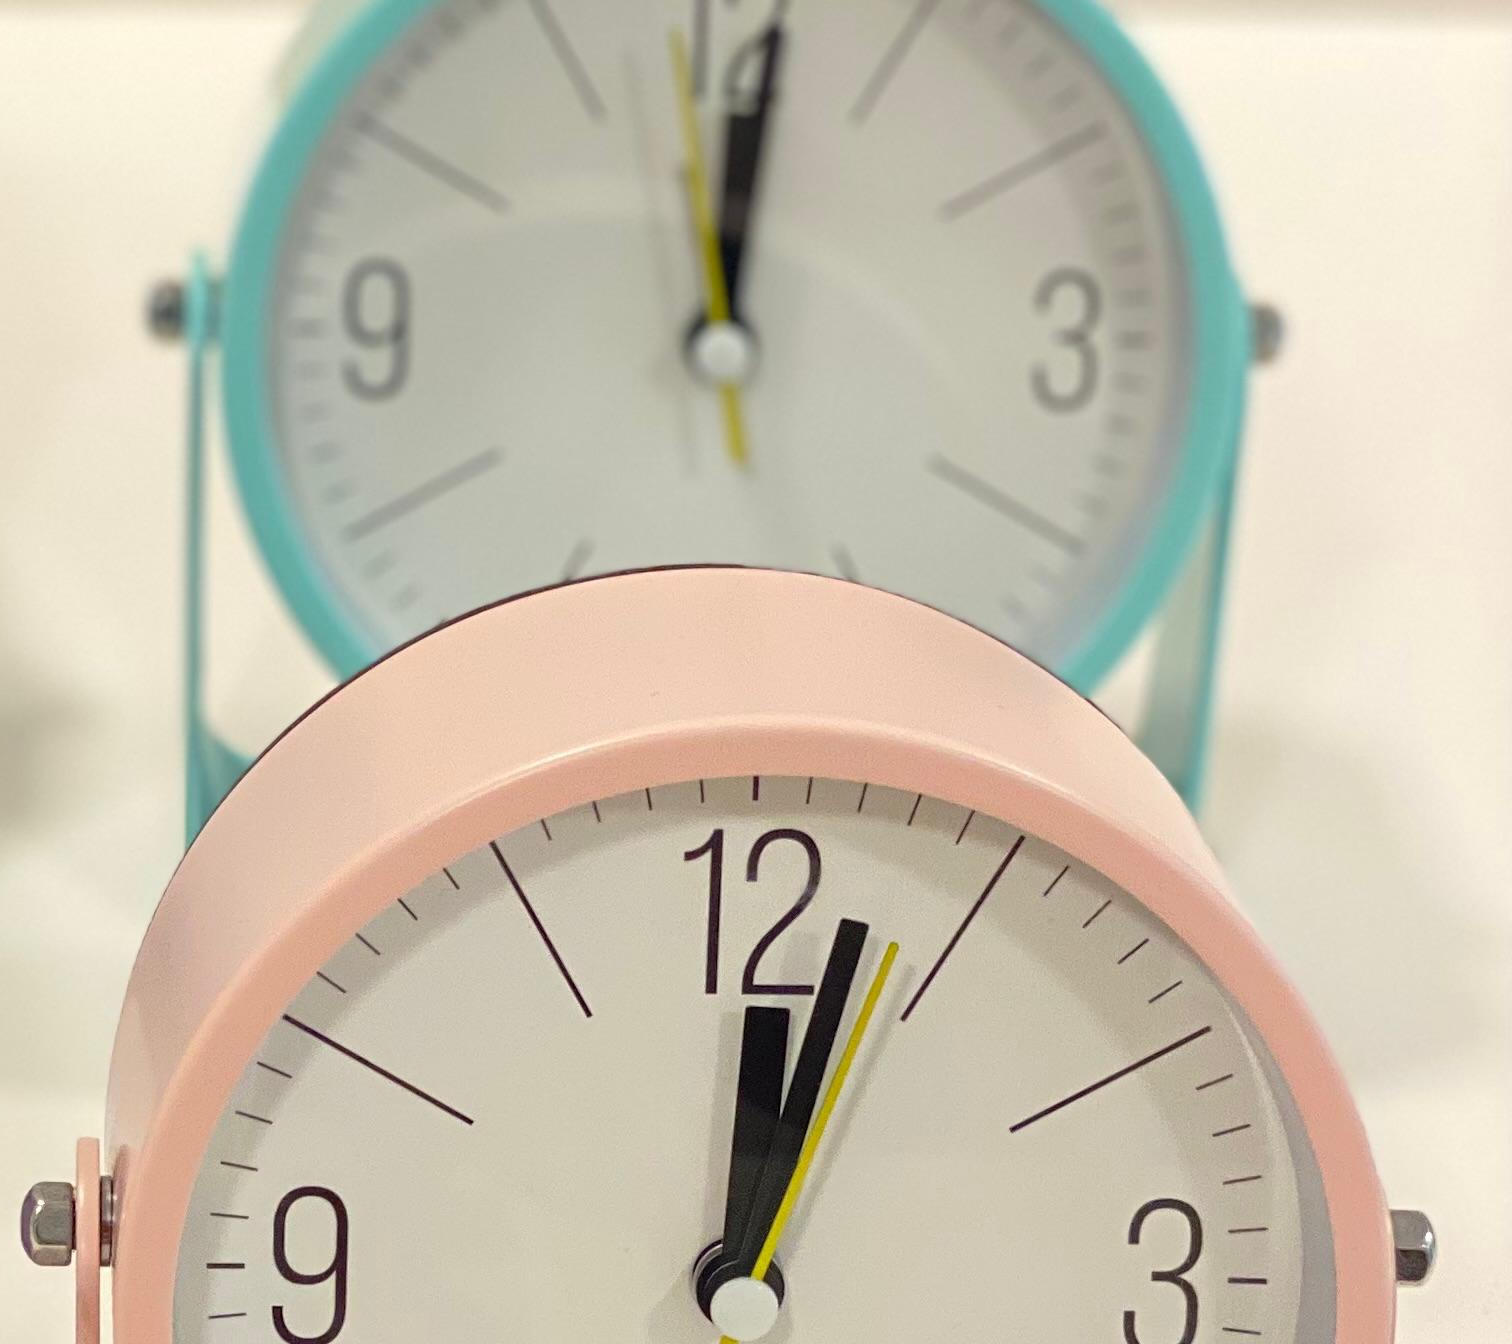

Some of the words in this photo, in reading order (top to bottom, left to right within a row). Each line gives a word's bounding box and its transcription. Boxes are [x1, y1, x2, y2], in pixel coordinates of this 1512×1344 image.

[339, 258, 414, 402] 9
[1028, 266, 1104, 414] 3
[682, 827, 823, 997] 12
